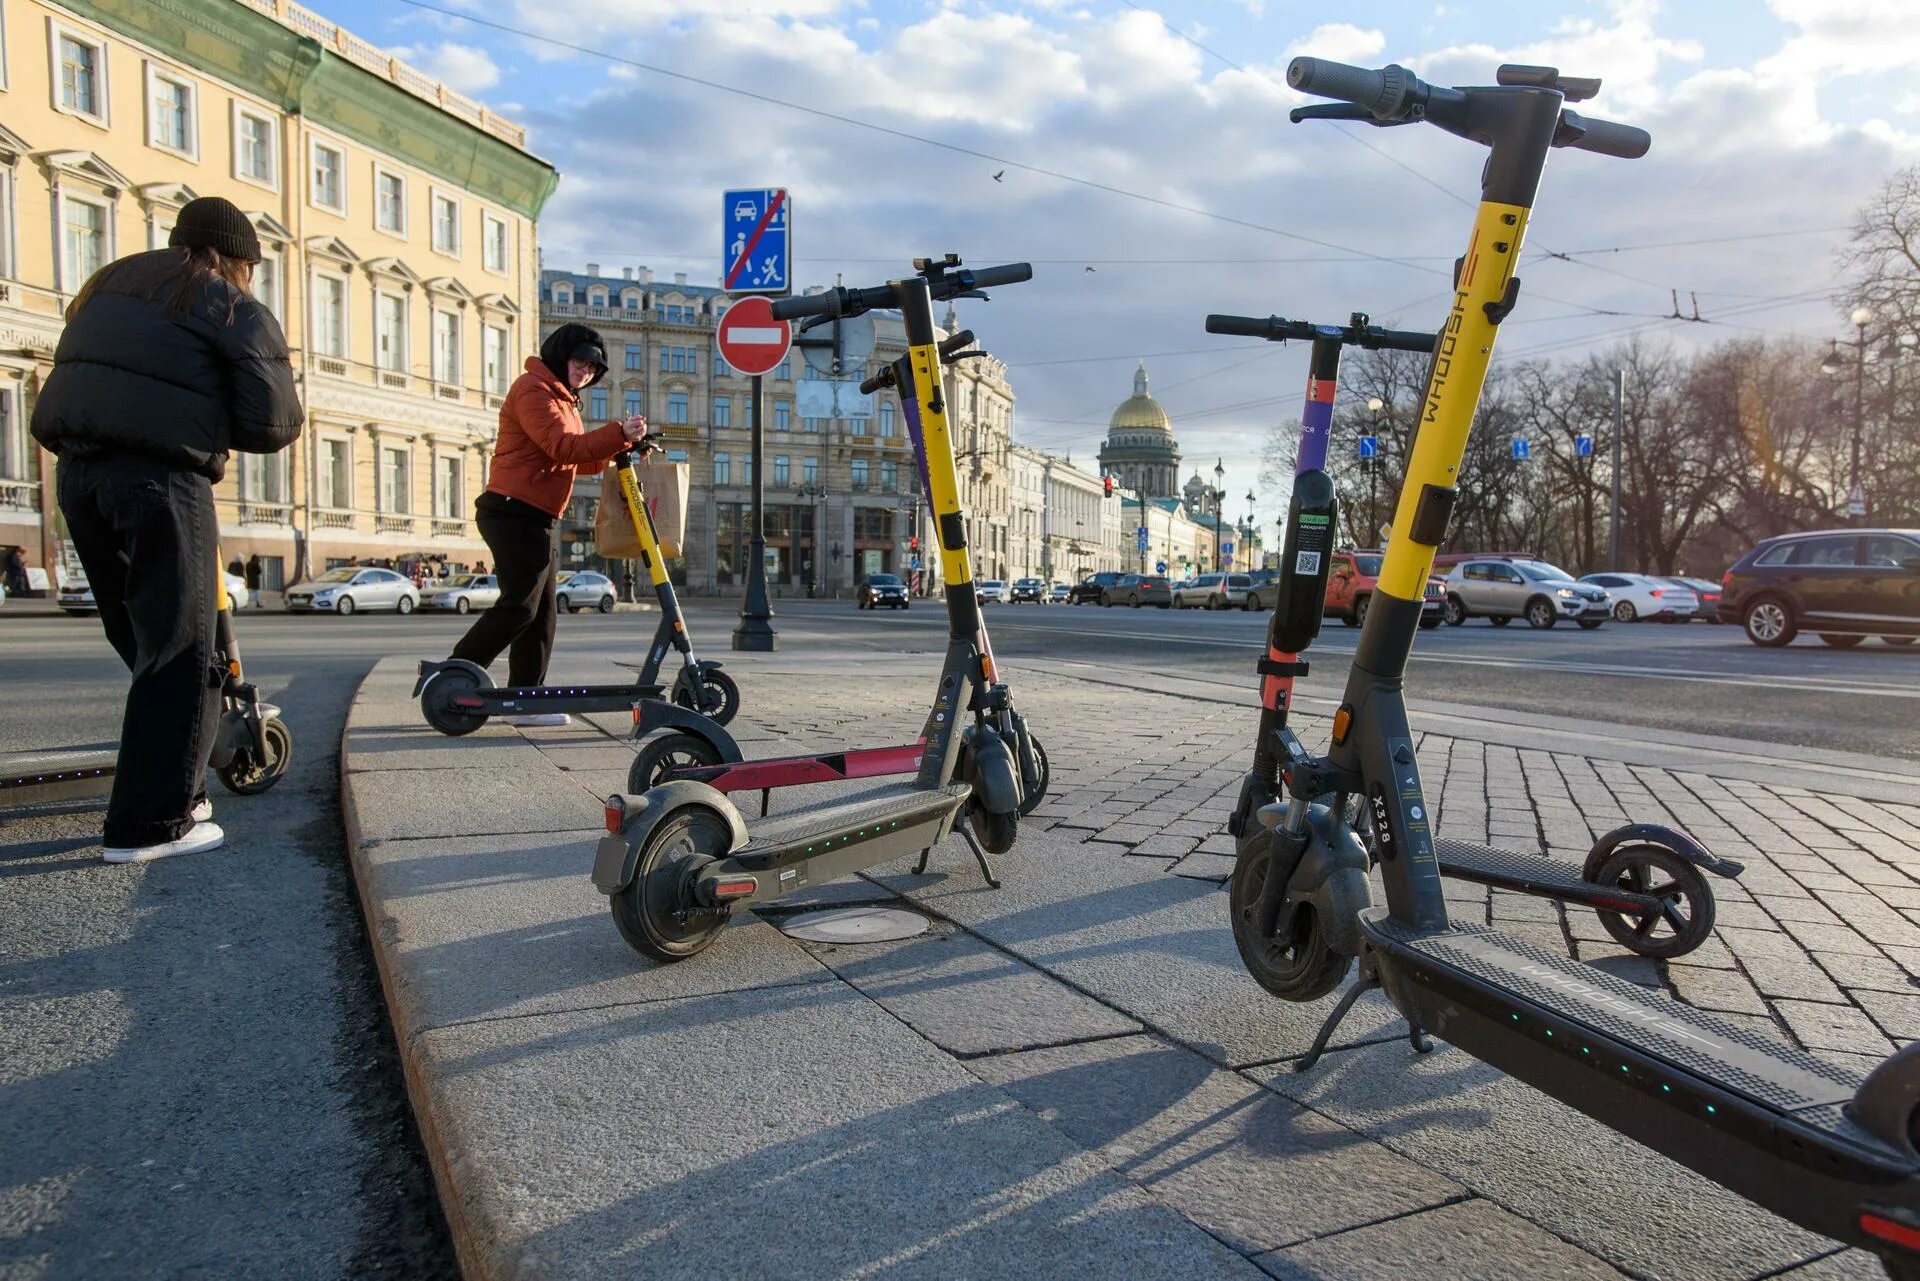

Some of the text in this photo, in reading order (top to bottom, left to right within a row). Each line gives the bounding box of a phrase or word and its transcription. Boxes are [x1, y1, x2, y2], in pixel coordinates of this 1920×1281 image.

[1424, 291, 1468, 423] WHOOSH
[627, 474, 644, 515] WHOOSH
[1372, 796, 1391, 844] X328
[1520, 965, 1661, 1022] WHOOSH
